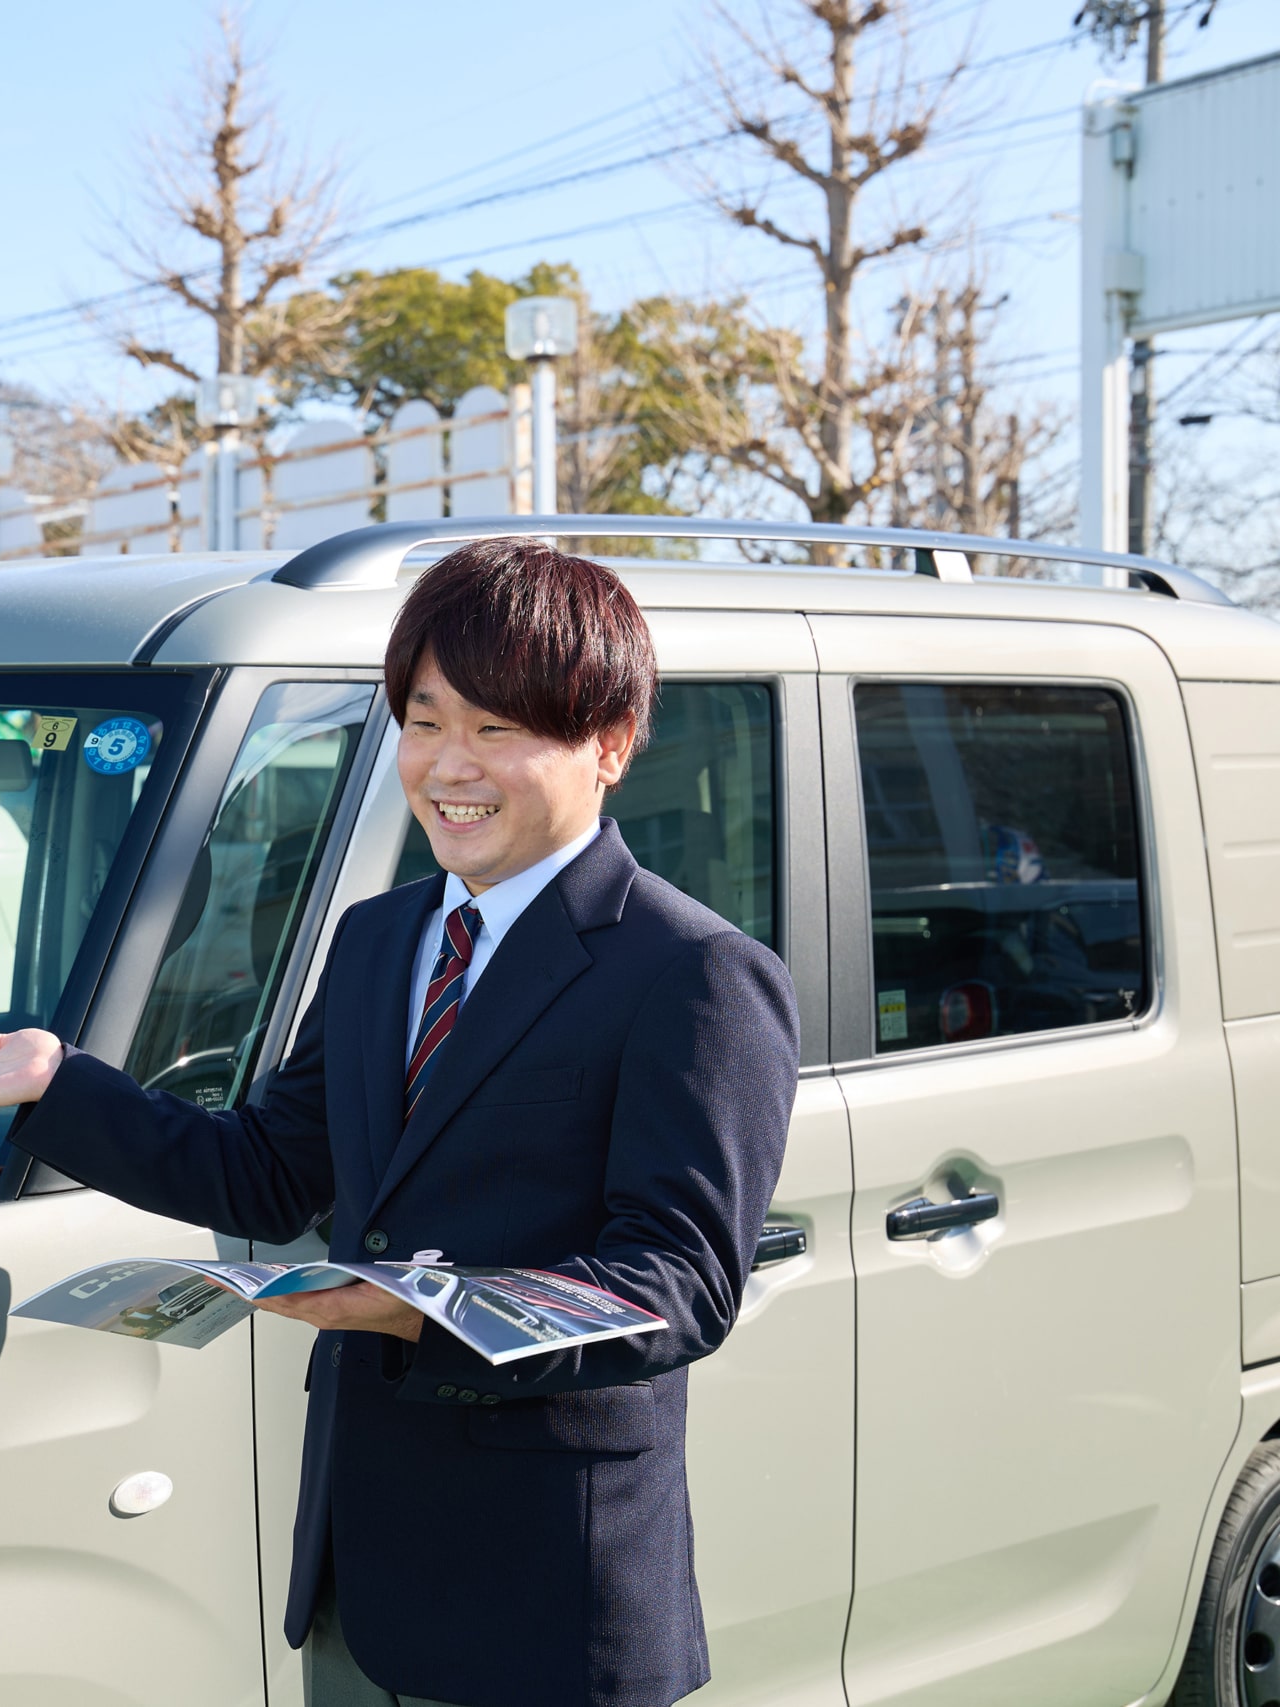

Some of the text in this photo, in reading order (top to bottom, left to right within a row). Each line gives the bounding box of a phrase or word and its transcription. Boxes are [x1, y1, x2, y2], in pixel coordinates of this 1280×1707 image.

[52, 721, 60, 731] 6
[90, 737, 99, 745] 9
[122, 721, 132, 729] 12
[43, 731, 57, 748] 9
[108, 737, 126, 756] 5
